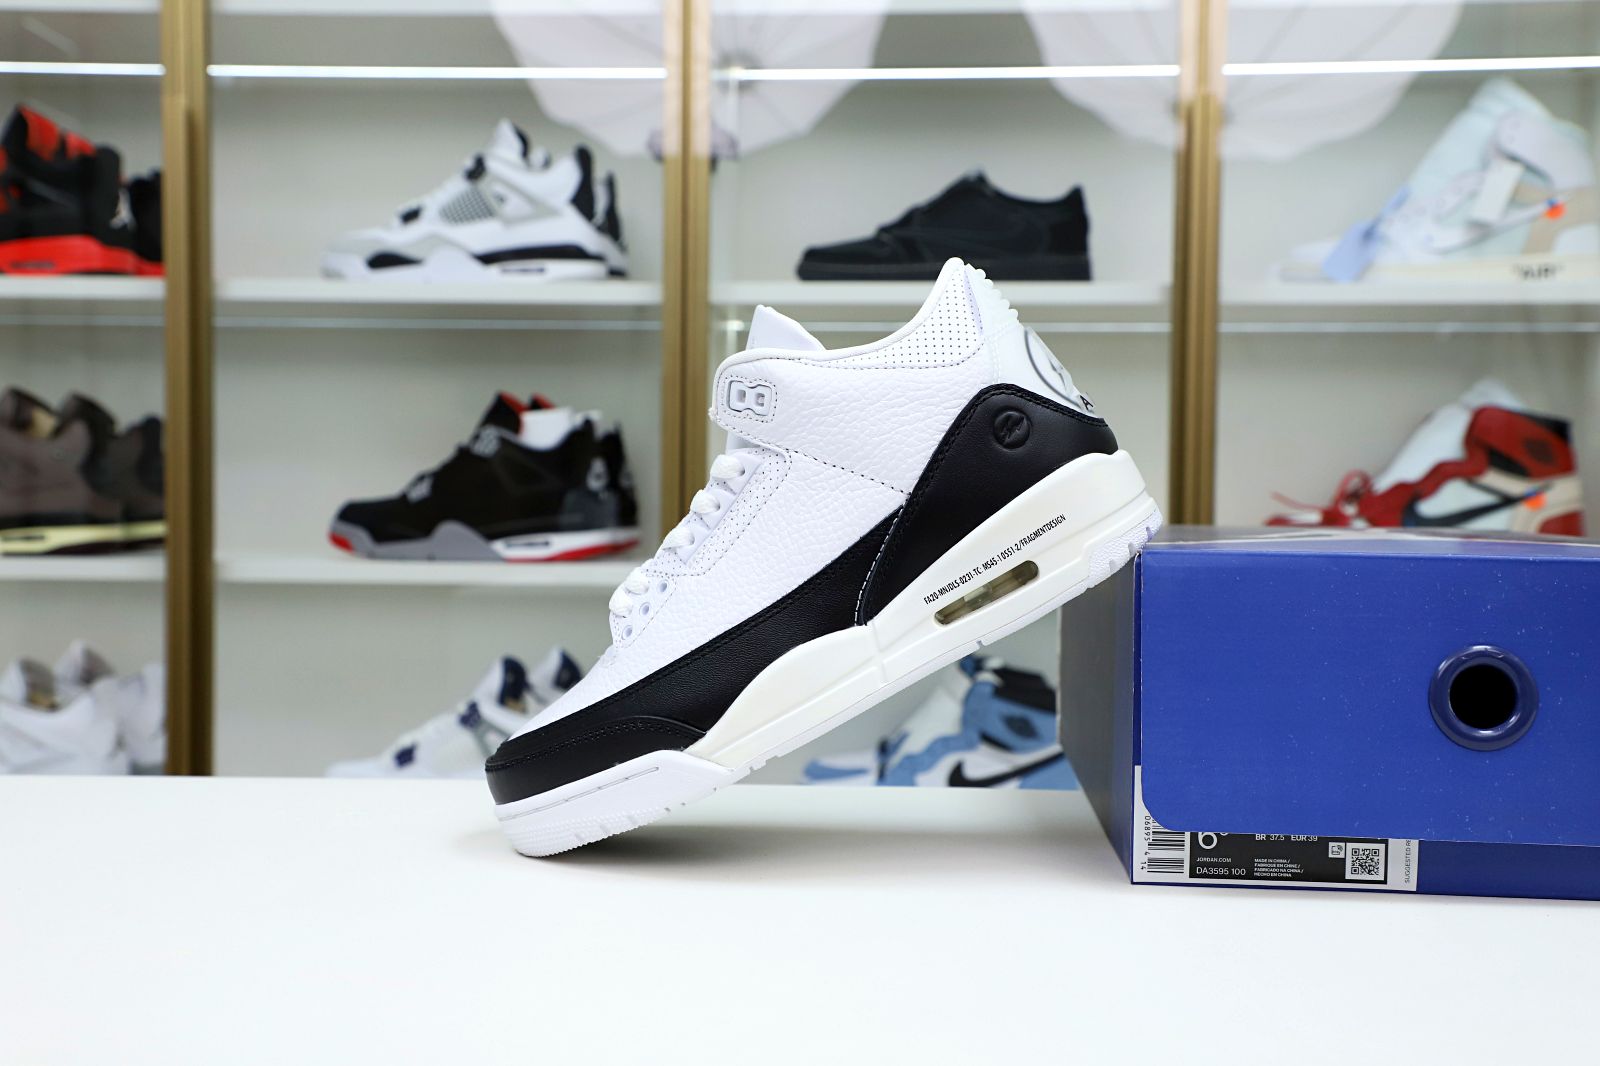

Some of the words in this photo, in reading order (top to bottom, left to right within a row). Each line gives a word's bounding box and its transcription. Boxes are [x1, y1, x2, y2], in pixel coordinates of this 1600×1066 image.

[1255, 833, 1266, 841] BR
[1290, 834, 1307, 842] EUR
[1196, 866, 1229, 875] DA3595
[1231, 868, 1246, 876] 100
